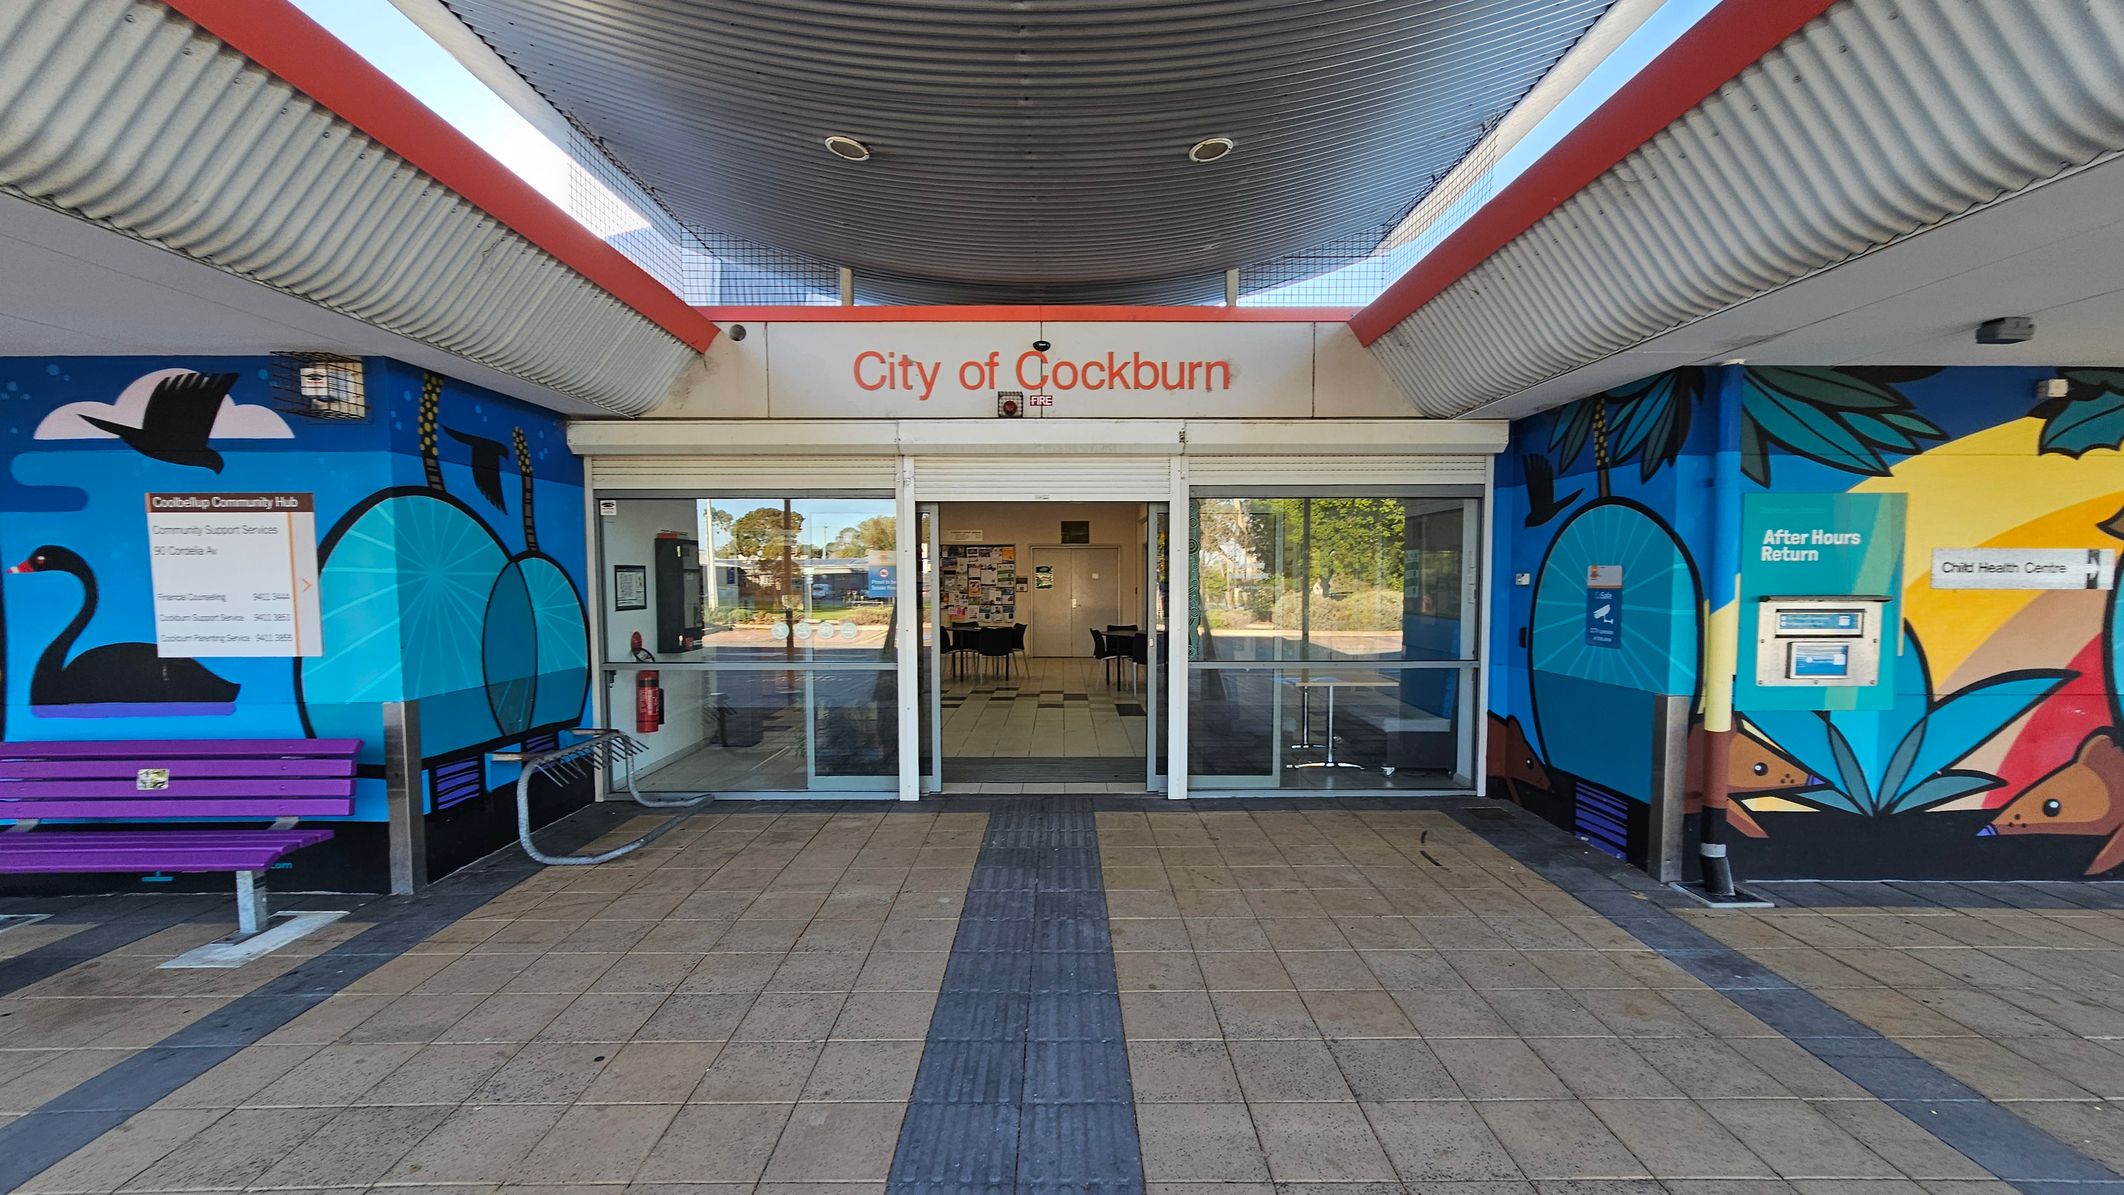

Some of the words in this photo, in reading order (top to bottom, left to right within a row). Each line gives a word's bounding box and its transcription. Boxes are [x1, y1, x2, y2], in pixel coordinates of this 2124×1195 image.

[853, 351, 941, 400] City
[959, 351, 999, 390] of
[1015, 351, 1230, 391] Cockburn
[1031, 396, 1052, 406] FIRE
[152, 496, 210, 509] Coolbellup
[211, 496, 273, 509] Community
[275, 496, 298, 507] Hub
[152, 525, 202, 536] Community
[205, 525, 240, 536] Support
[242, 525, 278, 535] Services
[1763, 529, 1809, 545] After
[1811, 529, 1861, 545] Hours
[1761, 546, 1819, 561] Return
[1942, 561, 1974, 574] Child
[1979, 562, 2020, 574] Health
[2024, 561, 2067, 574] Centre
